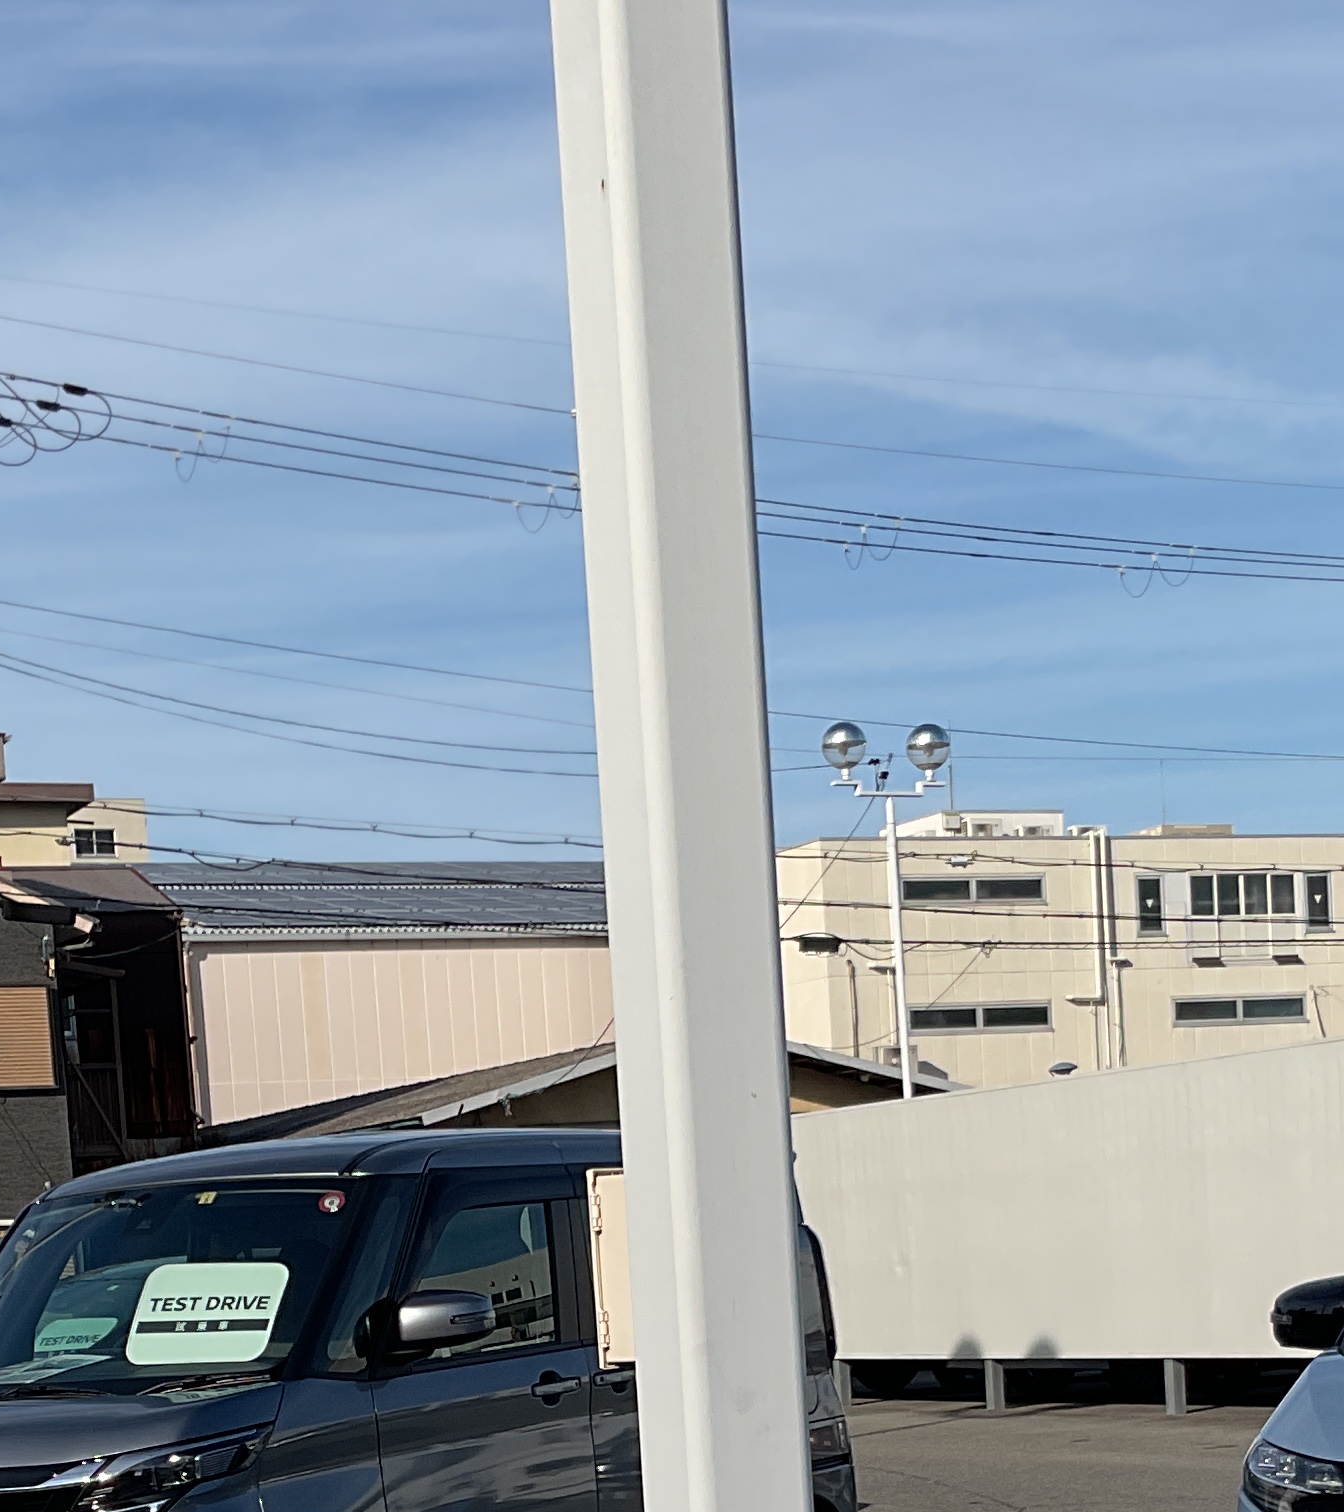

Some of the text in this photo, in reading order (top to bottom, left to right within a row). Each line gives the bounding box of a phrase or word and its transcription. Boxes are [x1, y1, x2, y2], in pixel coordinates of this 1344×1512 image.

[150, 1296, 271, 1312] TEST DRIVE
[39, 1333, 102, 1346] TEST DRIVE
